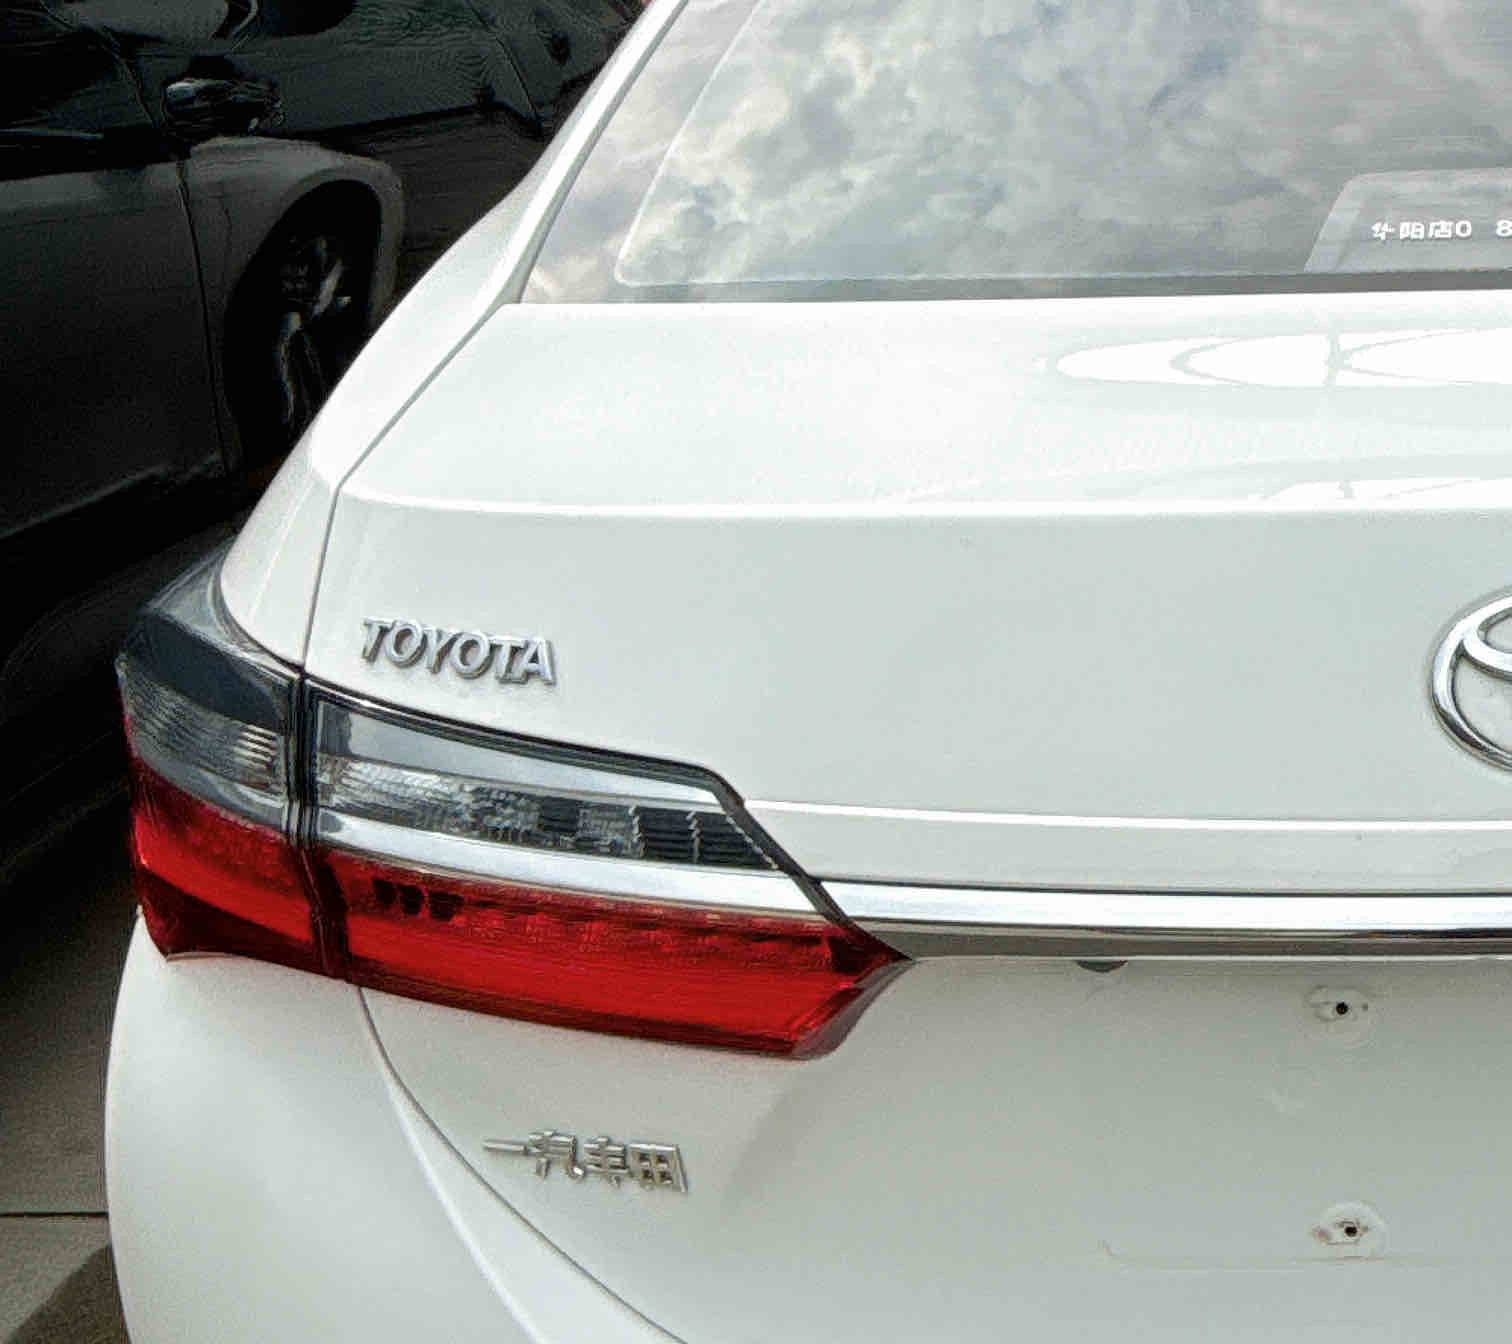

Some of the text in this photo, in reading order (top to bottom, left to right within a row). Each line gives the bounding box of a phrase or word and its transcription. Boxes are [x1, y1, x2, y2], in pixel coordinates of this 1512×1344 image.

[361, 616, 557, 687] TOYOTA
[482, 1128, 689, 1194] 一汽丰田
